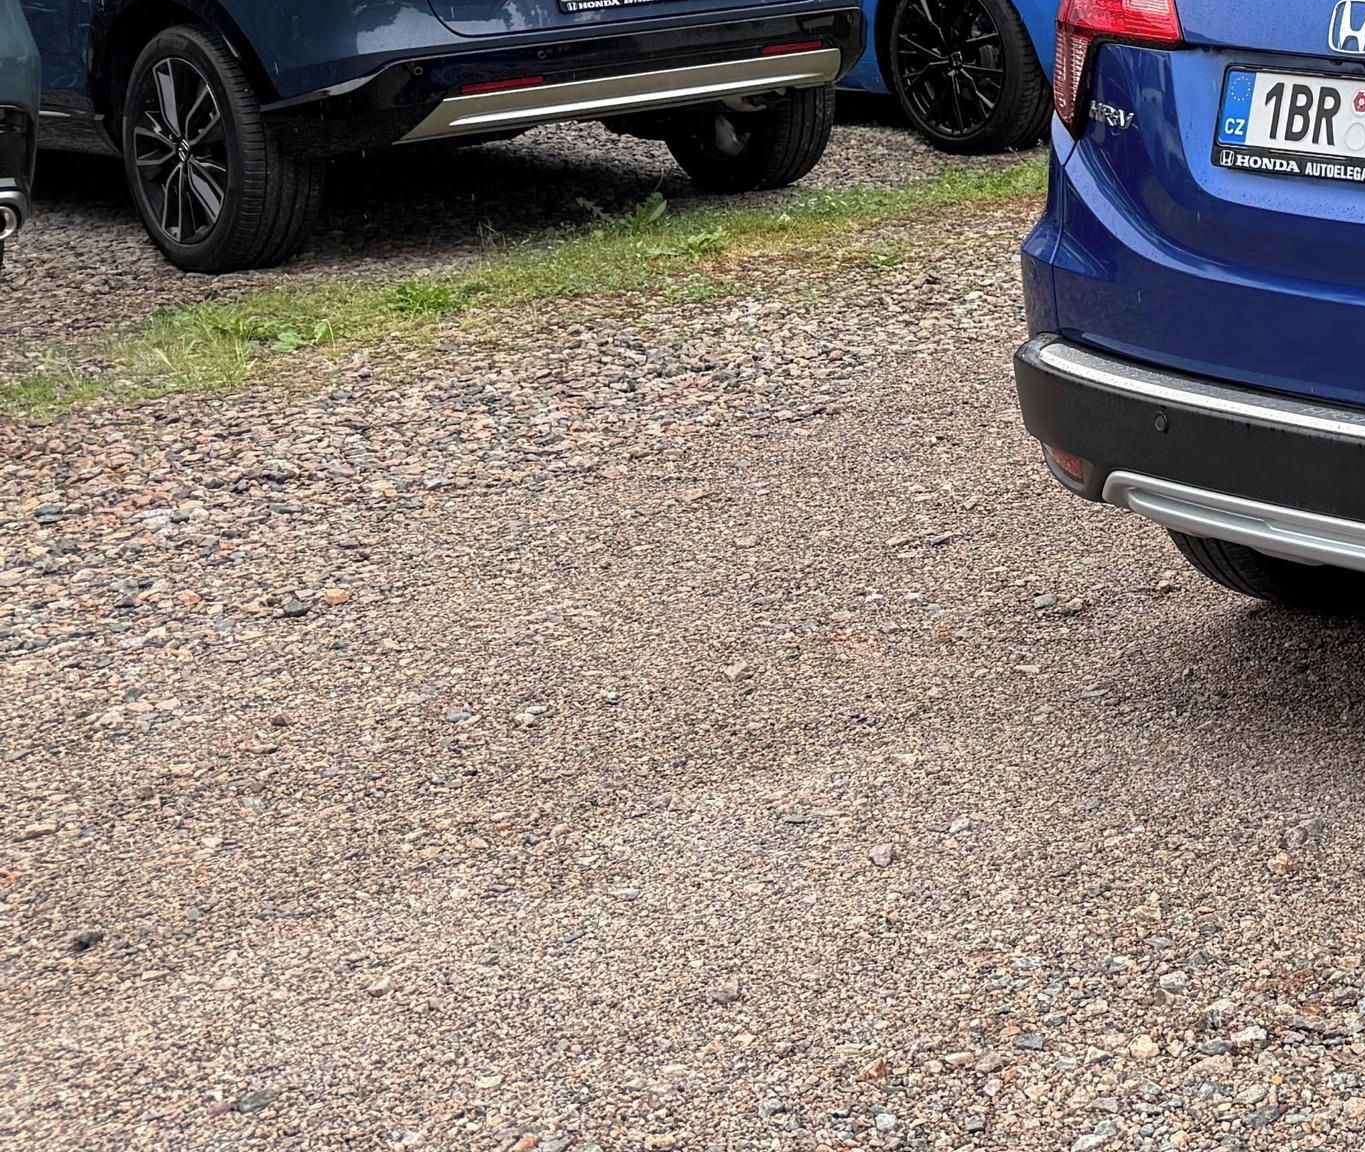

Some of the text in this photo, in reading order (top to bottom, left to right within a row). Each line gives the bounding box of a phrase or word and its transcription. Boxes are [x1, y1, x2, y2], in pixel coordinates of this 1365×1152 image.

[1264, 81, 1342, 146] 1BR
[1224, 118, 1245, 136] CZ
[1235, 153, 1301, 174] HONDA
